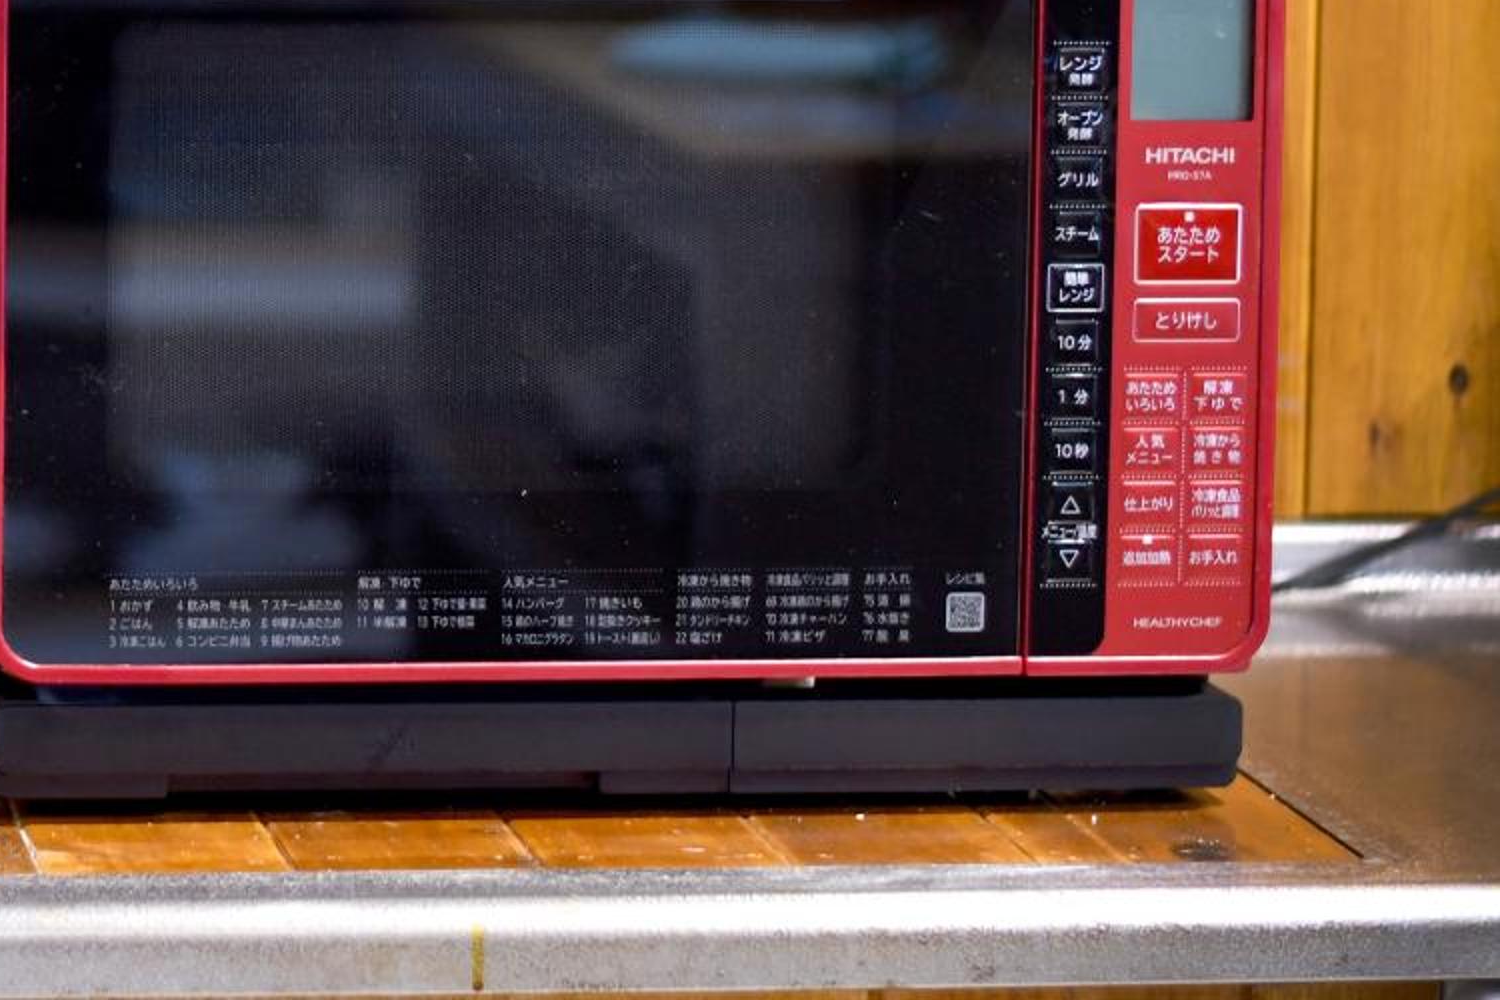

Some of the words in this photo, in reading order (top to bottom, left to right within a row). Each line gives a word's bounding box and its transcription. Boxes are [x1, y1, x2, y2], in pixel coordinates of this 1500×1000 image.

[1060, 55, 1102, 71] レンジ
[1145, 147, 1235, 164] HITACHI
[1057, 172, 1099, 187] グリル
[1055, 226, 1099, 242] スチーム
[1157, 226, 1221, 245] あたため
[1157, 245, 1220, 264] スタート
[1059, 287, 1095, 302] レンジ
[1155, 311, 1218, 330] とりけし
[1125, 381, 1178, 395] あたため
[1125, 396, 1176, 411] いろいろ
[1125, 450, 1173, 465] メニュー
[1123, 495, 1173, 513] 仕上がり
[1189, 550, 1238, 566] お手入れ
[503, 576, 569, 590] 人気メニュー
[864, 572, 912, 586] お手入れ
